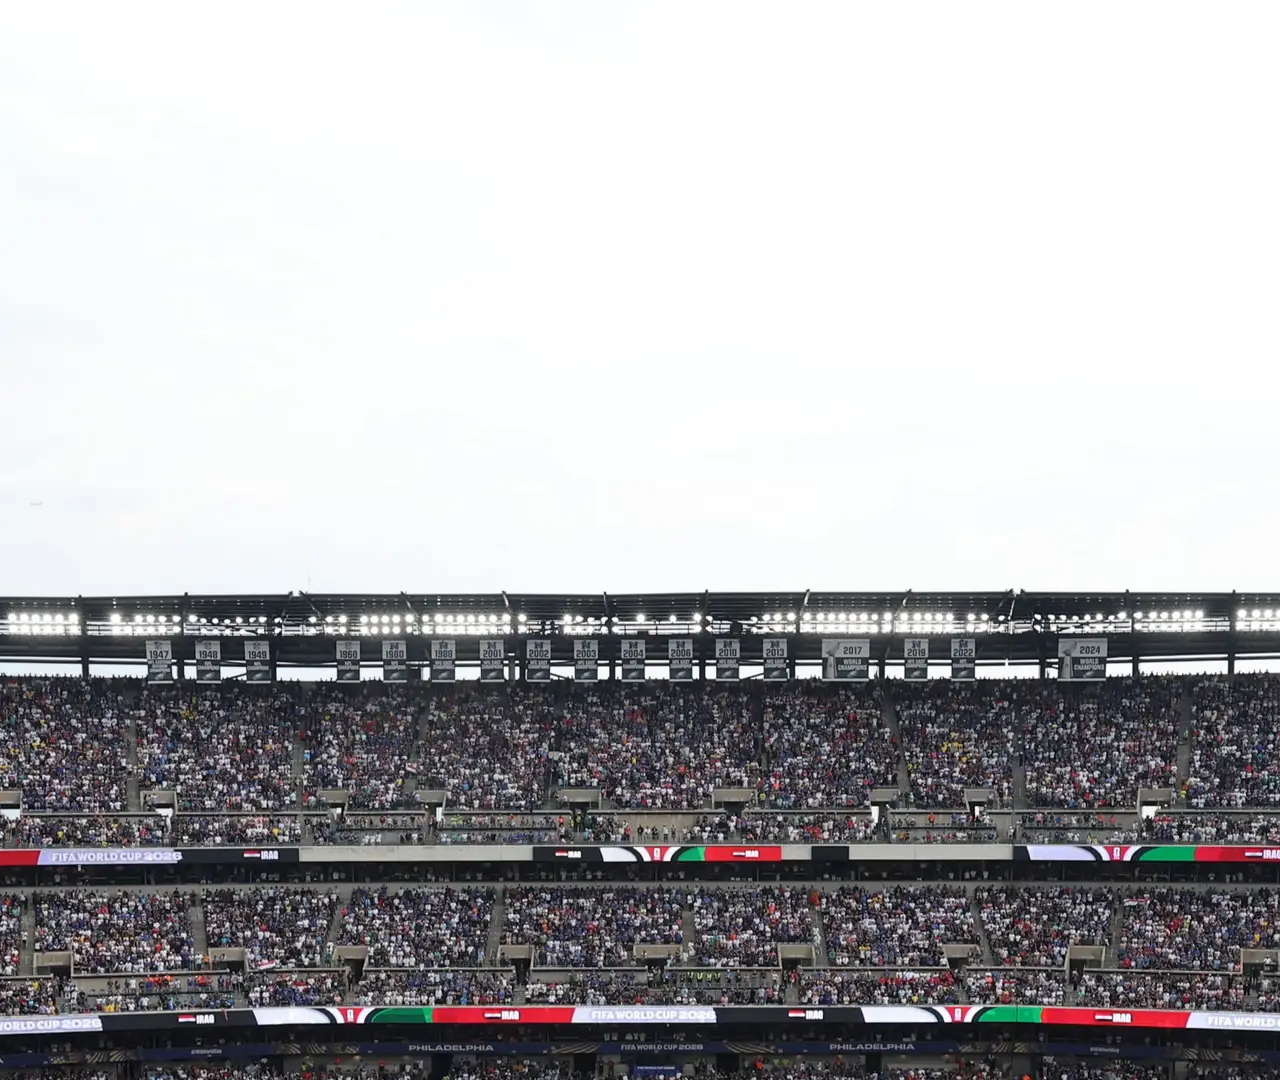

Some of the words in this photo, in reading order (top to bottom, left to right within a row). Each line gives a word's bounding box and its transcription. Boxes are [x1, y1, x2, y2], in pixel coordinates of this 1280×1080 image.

[248, 651, 267, 659] 1949
[1080, 646, 1100, 654] 2024
[52, 852, 74, 862] FIFA
[77, 852, 116, 862] WORLD
[120, 852, 142, 861] CUP
[143, 852, 182, 861] 2026
[260, 850, 279, 860] IRAQ
[196, 1014, 214, 1024] IRAQ
[502, 1011, 520, 1020] IRAQ
[591, 1011, 614, 1020] FIFA
[615, 1011, 656, 1020] WORLD
[656, 1011, 677, 1020] CUP
[678, 1011, 717, 1020] 2026
[805, 1010, 823, 1020] IRAQ
[1112, 1013, 1131, 1023] IRAQ
[37, 1020, 60, 1030] CUP
[61, 1019, 102, 1029] 2026
[1208, 1016, 1231, 1026] FIFA
[1232, 1017, 1275, 1028] WORLD
